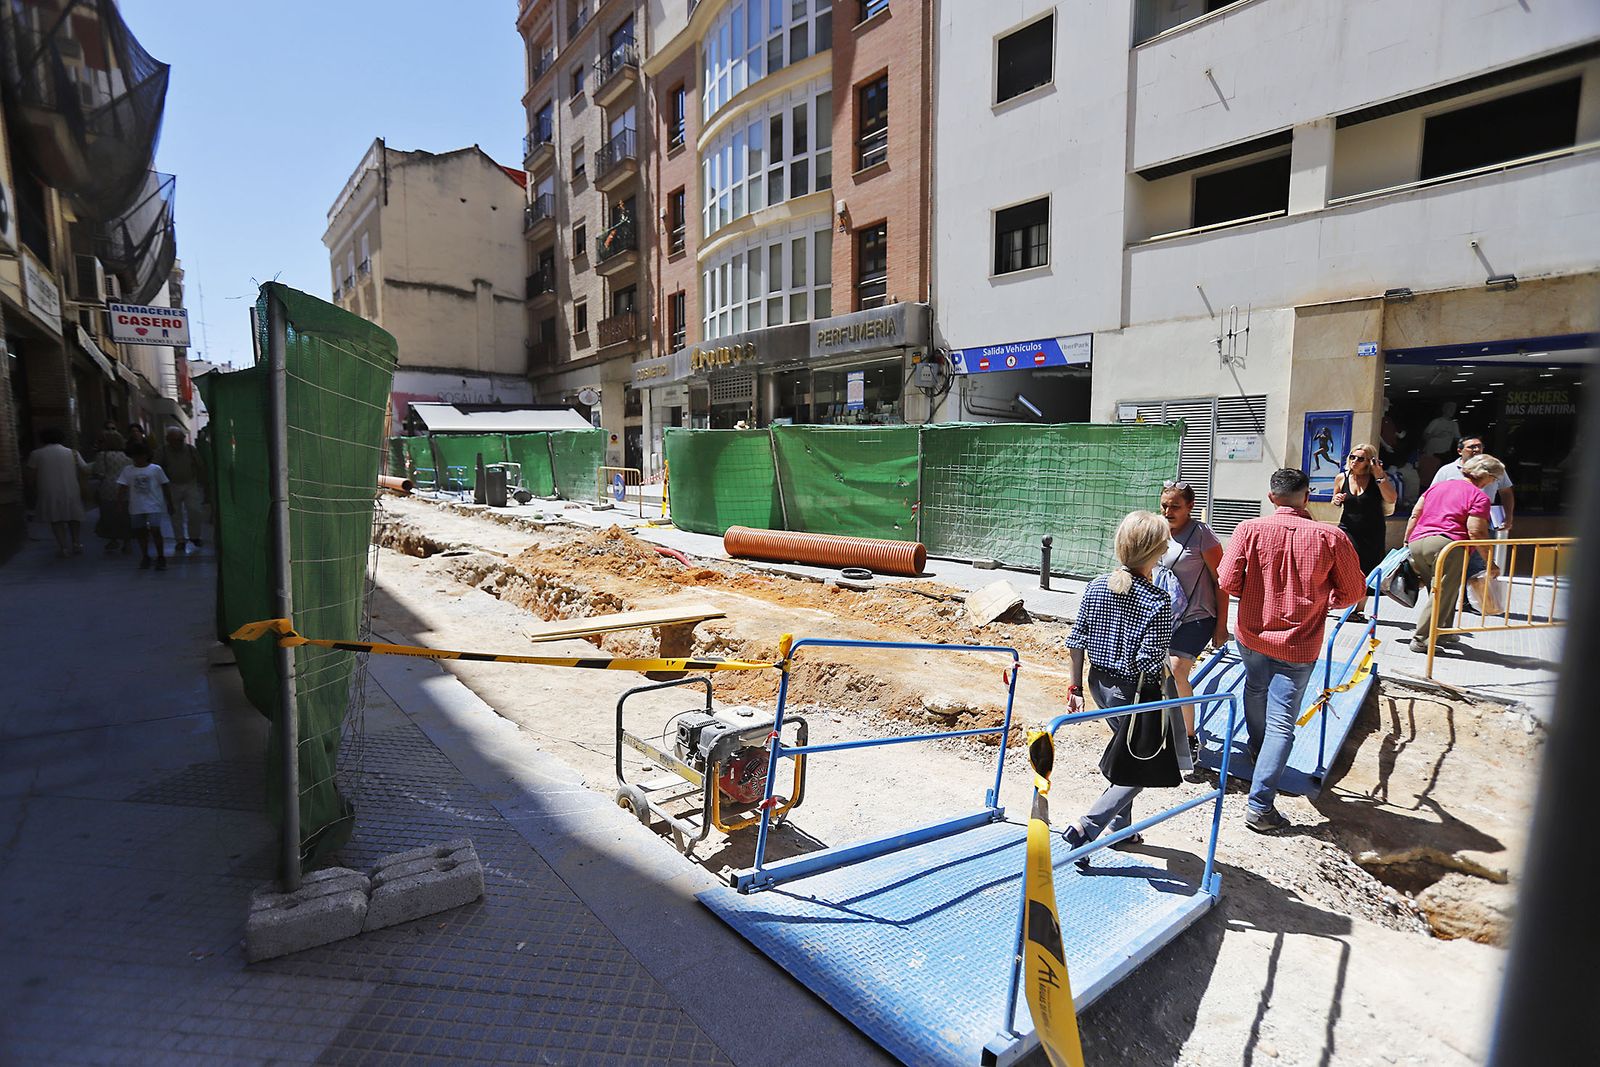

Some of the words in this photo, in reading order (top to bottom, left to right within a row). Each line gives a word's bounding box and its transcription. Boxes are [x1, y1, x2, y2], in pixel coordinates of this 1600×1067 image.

[112, 305, 186, 317] ALMACENES
[118, 315, 183, 328] CASERO
[982, 347, 1005, 356] Salida
[1005, 342, 1042, 354] Vehículos
[1506, 391, 1569, 404] SKECHERS
[1505, 403, 1525, 415] MÁS
[1527, 403, 1576, 415] AVENTURA
